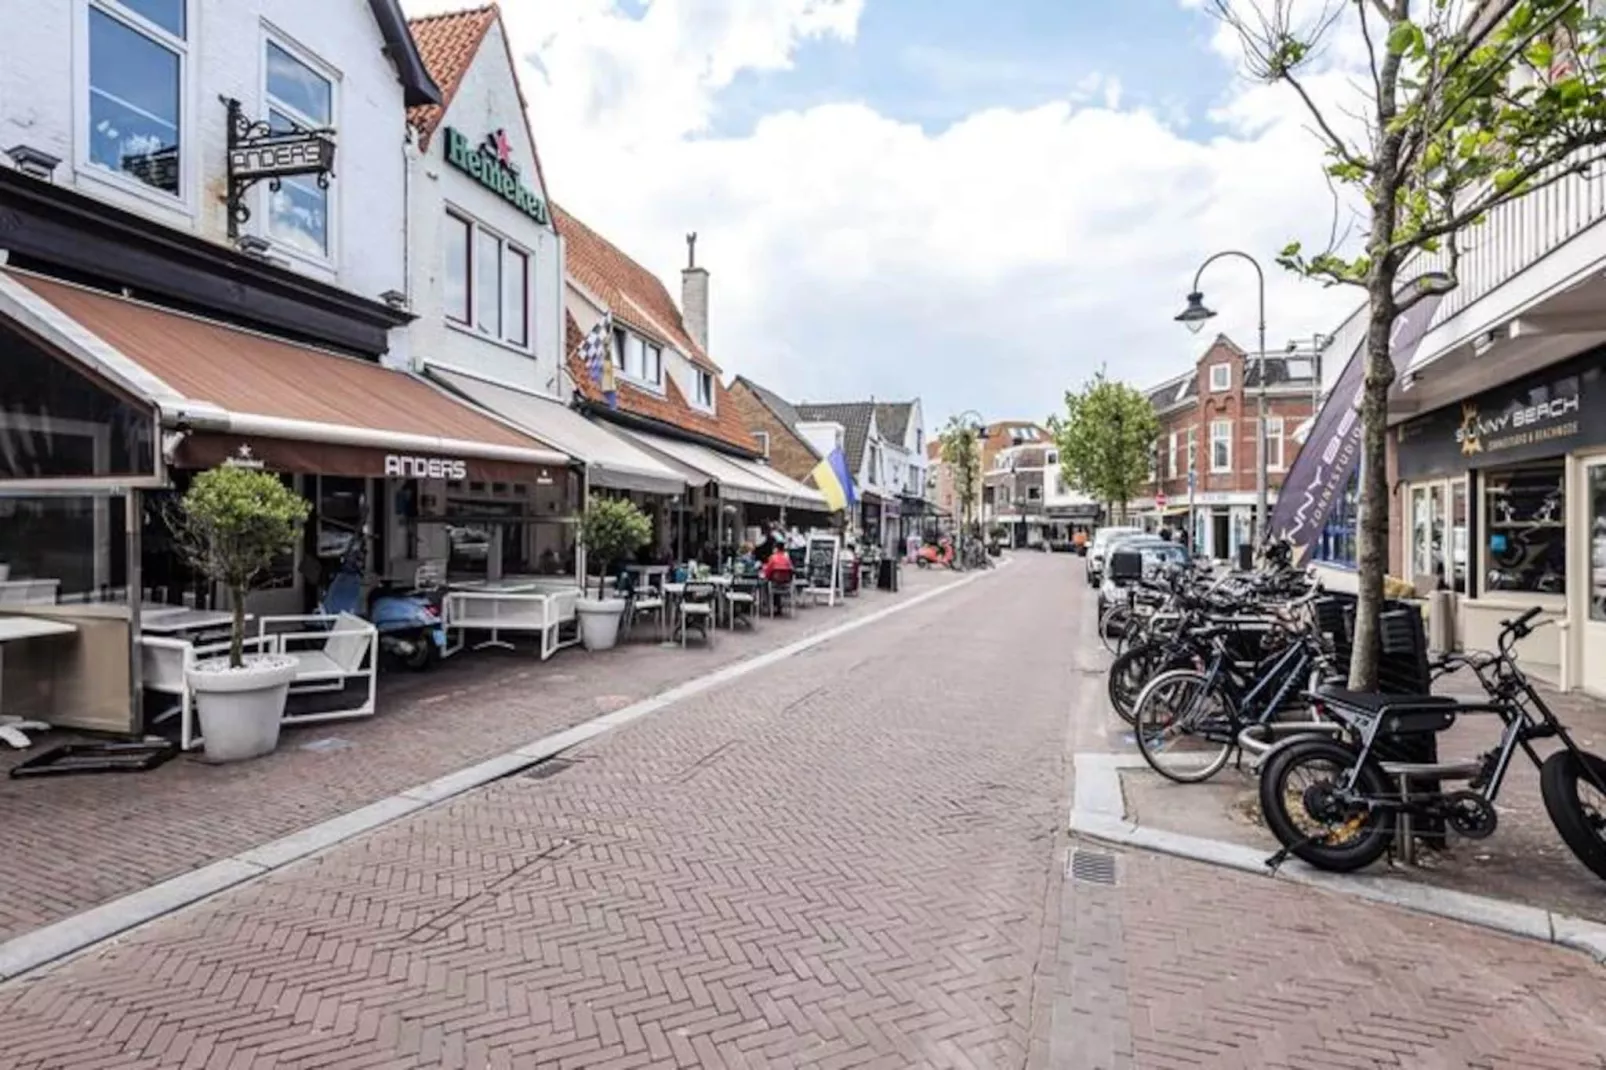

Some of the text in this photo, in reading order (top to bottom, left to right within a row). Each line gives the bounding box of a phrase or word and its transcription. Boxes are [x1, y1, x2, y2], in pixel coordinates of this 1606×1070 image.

[231, 143, 320, 172] ANDERS
[448, 127, 546, 222] Heineken
[1512, 393, 1580, 428] BEACH
[384, 454, 467, 479] ANDERS
